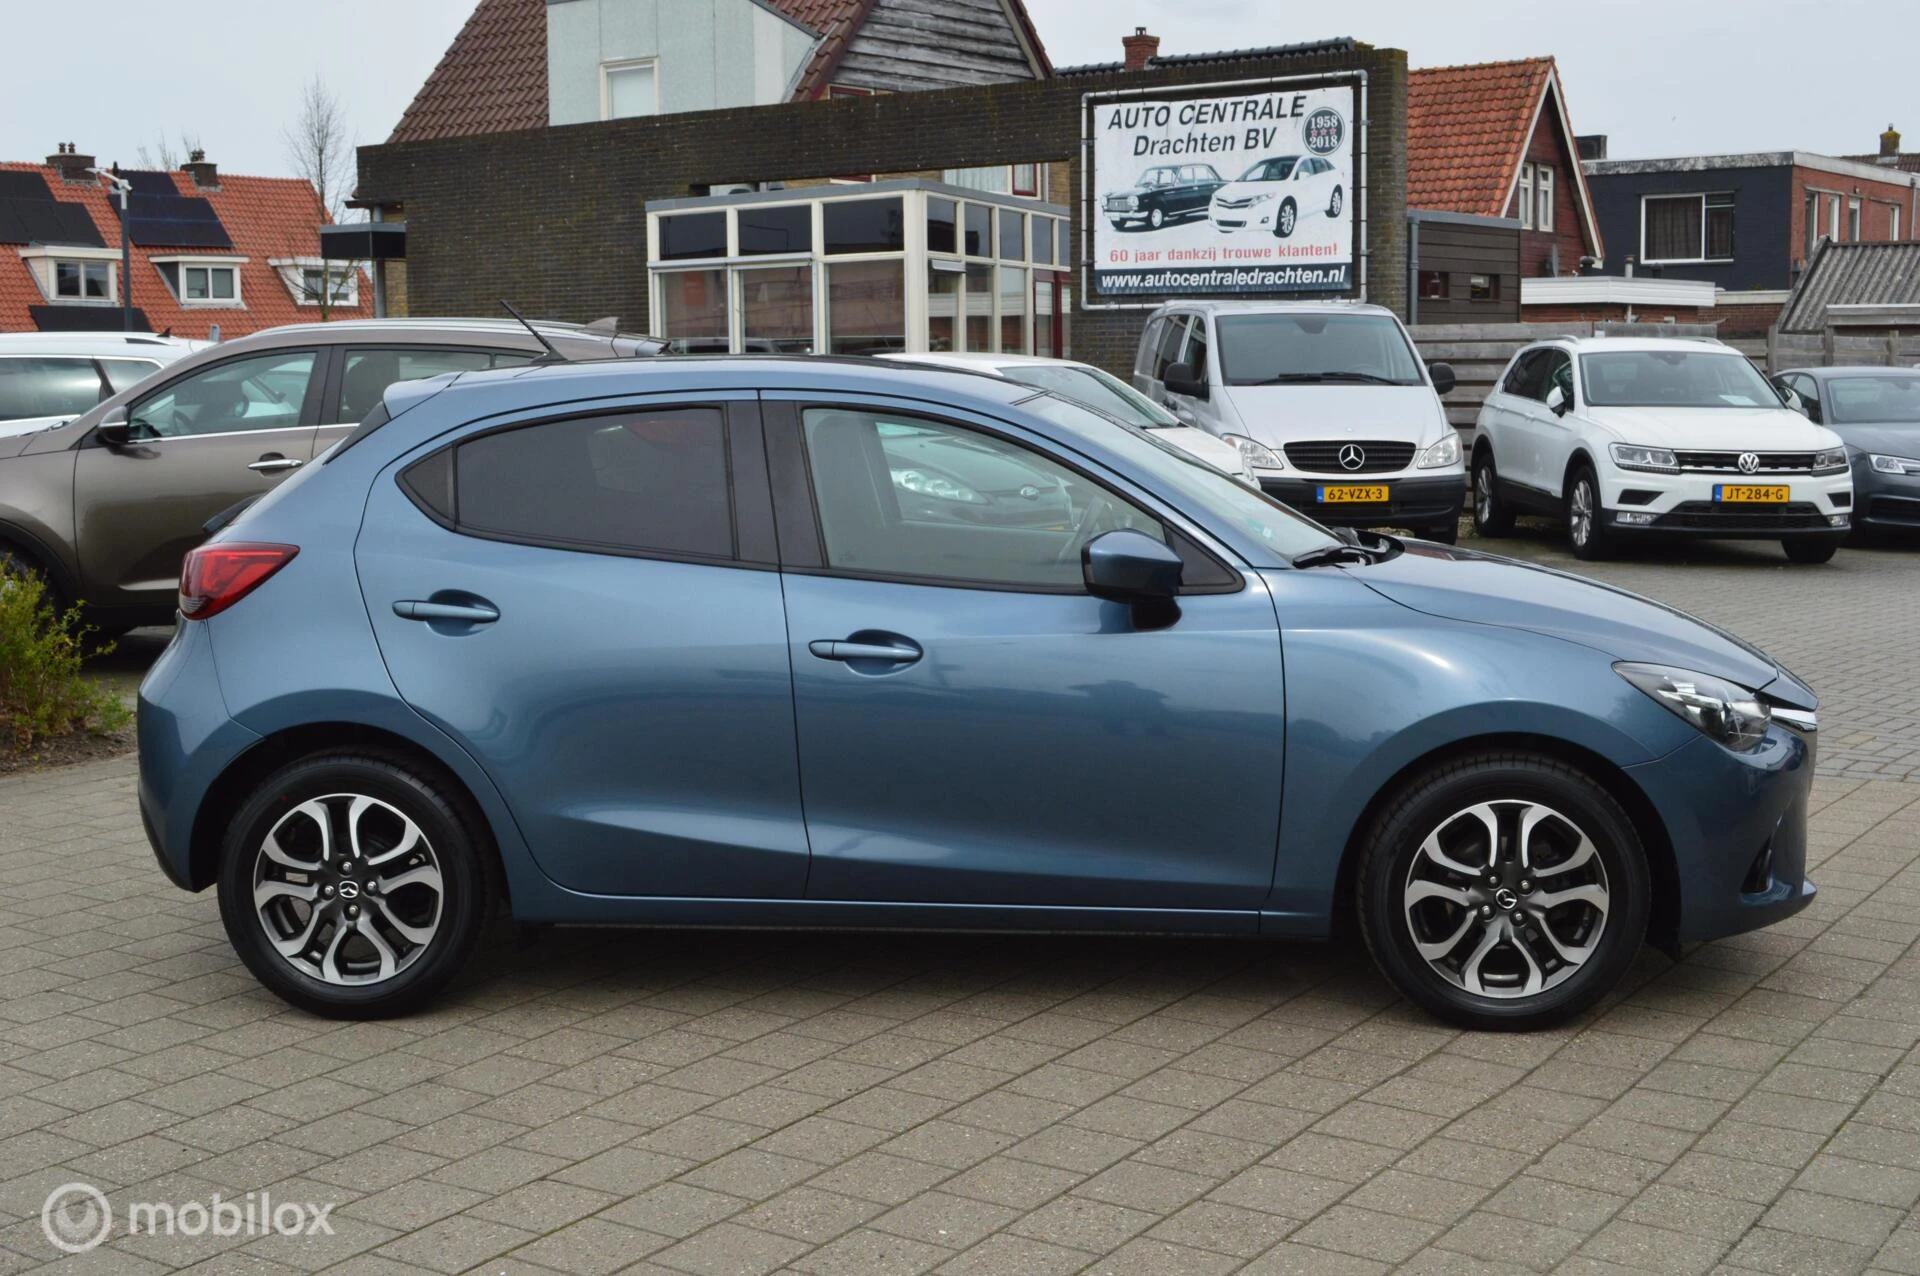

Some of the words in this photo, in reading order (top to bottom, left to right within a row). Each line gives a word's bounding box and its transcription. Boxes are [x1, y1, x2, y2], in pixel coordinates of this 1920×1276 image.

[1107, 104, 1171, 130] AUTO
[1178, 95, 1307, 126] CENTRALE
[1309, 115, 1339, 129] 1958
[1133, 131, 1236, 156] Drachten
[1244, 126, 1277, 150] BV
[1309, 135, 1339, 148] 2018
[1110, 249, 1129, 262] 60
[1134, 249, 1161, 263] jaar
[1167, 247, 1217, 262] dankzij
[1223, 247, 1272, 259] trouwe
[1278, 243, 1338, 257] klanten!
[1101, 265, 1346, 288] www.autocentraledrachten.nl
[1328, 487, 1383, 500] 62-VZX-3
[1726, 487, 1784, 500] JT-284-G
